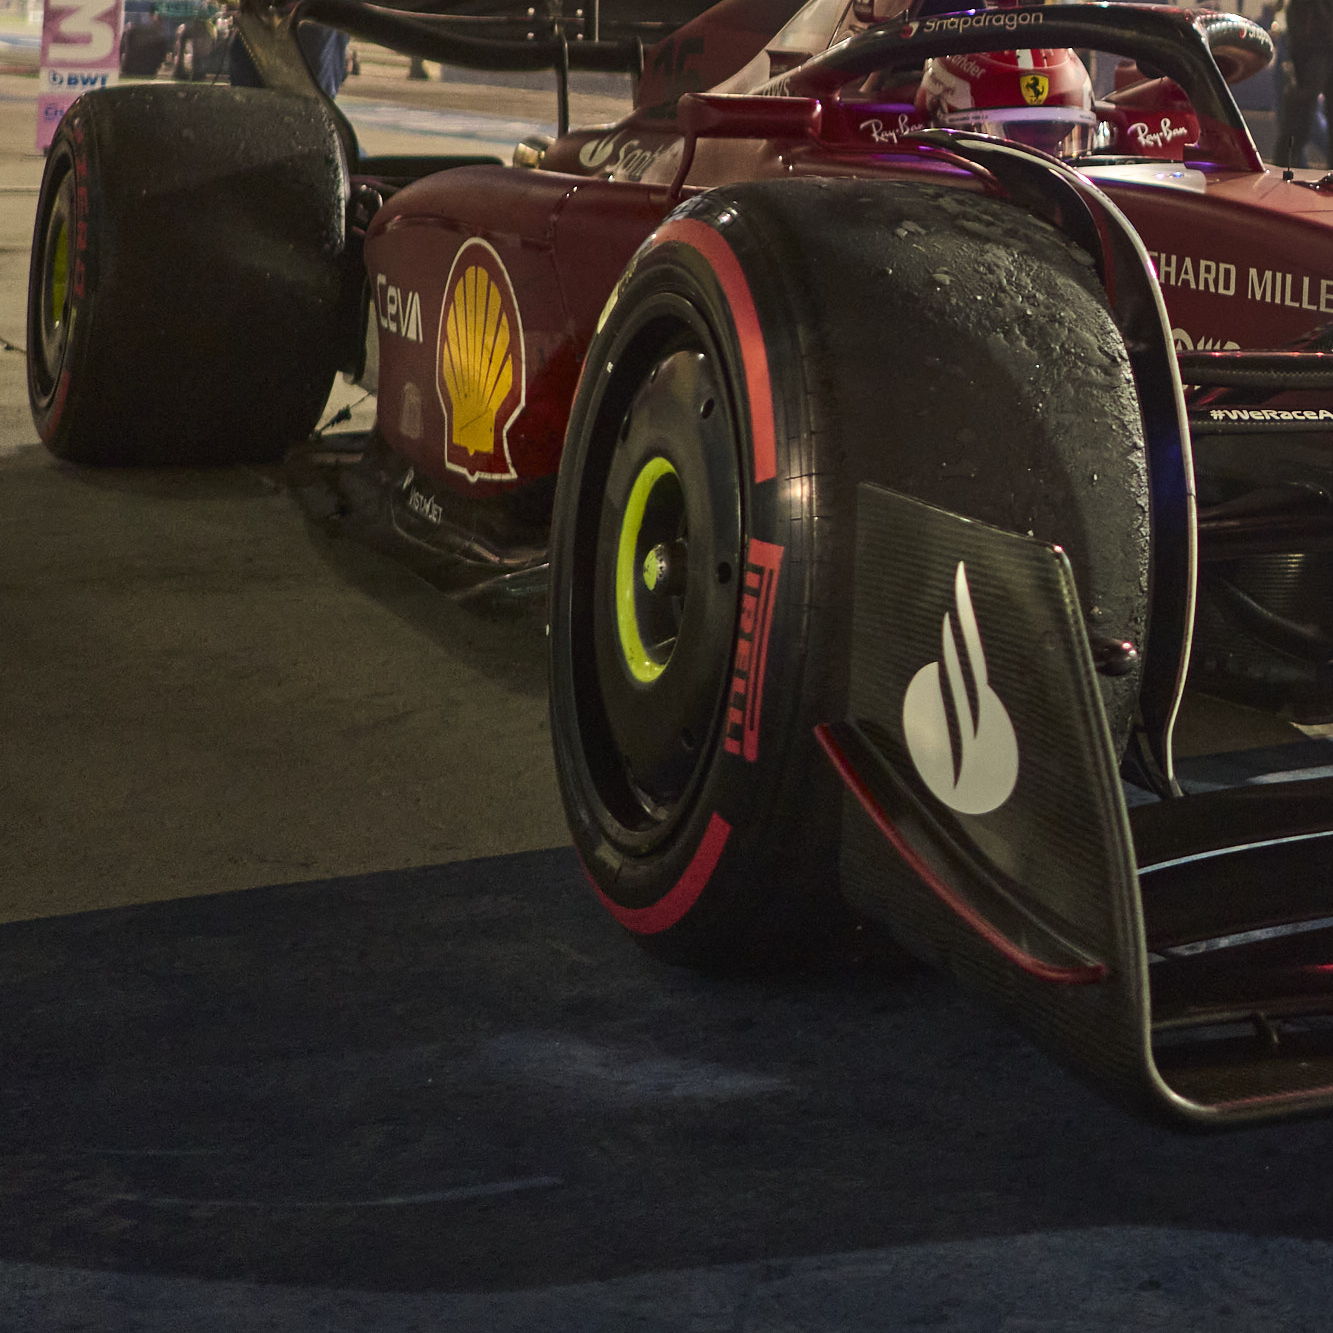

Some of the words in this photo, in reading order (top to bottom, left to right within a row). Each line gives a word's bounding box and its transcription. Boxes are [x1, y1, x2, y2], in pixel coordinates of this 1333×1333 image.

[923, 11, 1044, 34] Snapdragon
[66, 73, 109, 87] BWT
[1127, 117, 1188, 148] Ray-Ban
[724, 537, 786, 763] PIRELLI
